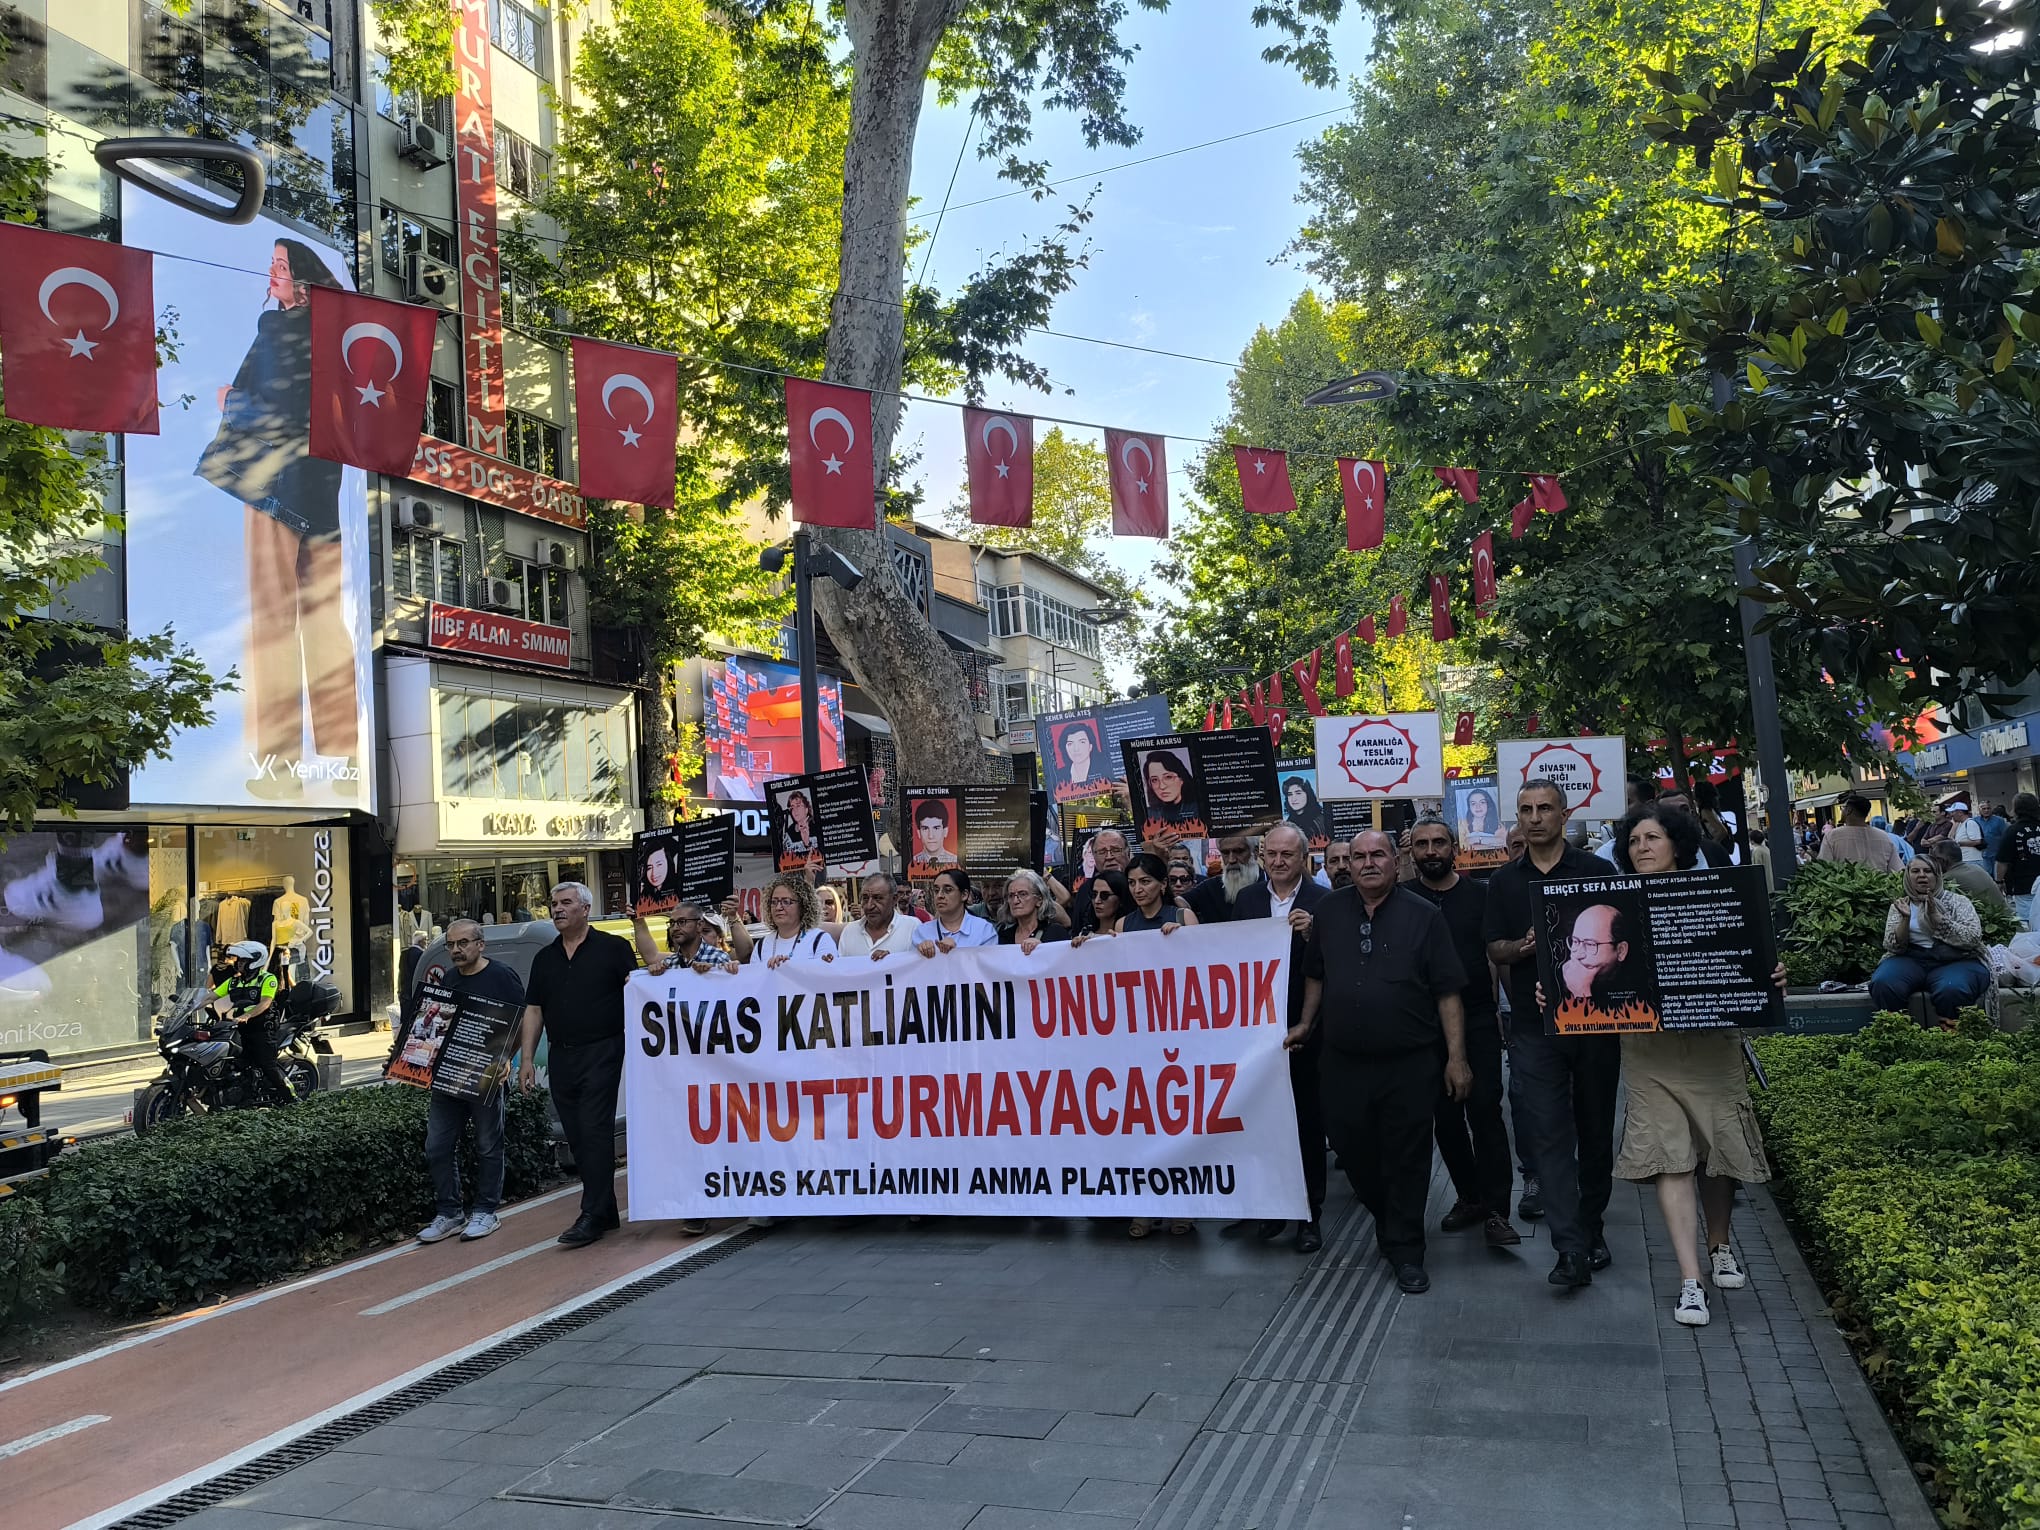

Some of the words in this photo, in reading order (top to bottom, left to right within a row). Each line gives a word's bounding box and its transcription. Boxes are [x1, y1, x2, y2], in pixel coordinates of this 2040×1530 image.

[459, 0, 490, 185] MURAT
[465, 208, 506, 460] EĞİTİM
[470, 460, 515, 500] DGS
[531, 474, 584, 520] ÖABT
[468, 622, 510, 646] ALAN
[521, 632, 568, 657] SMMM
[1156, 737, 1182, 746] AKARSU
[1355, 737, 1403, 747] KARANLIĞA
[1363, 746, 1394, 756] TESLİM
[1346, 756, 1404, 767] OLMAYACAĞIZ
[1538, 763, 1576, 773] SİVAS'IN
[906, 788, 925, 796] AHMET
[484, 812, 538, 835] KAYA
[310, 829, 333, 914] Koza
[1543, 884, 1580, 897] BEHÇET
[1582, 882, 1607, 893] SEFA
[1610, 879, 1642, 891] ASLAN
[310, 917, 333, 983] Yeni
[641, 987, 762, 1057] SİVAS
[777, 974, 1016, 1051] KATLİAMINI
[1028, 958, 1281, 1038] UNUTMADIK
[28, 1021, 82, 1042] Koza
[687, 1048, 1245, 1144] UNUTTURMAYACAĞIZ
[704, 1165, 786, 1198] SİVAS
[796, 1162, 959, 1196] KATLİAMINI
[968, 1167, 1052, 1195] ANMA
[1061, 1164, 1236, 1195] PLATFORMU
